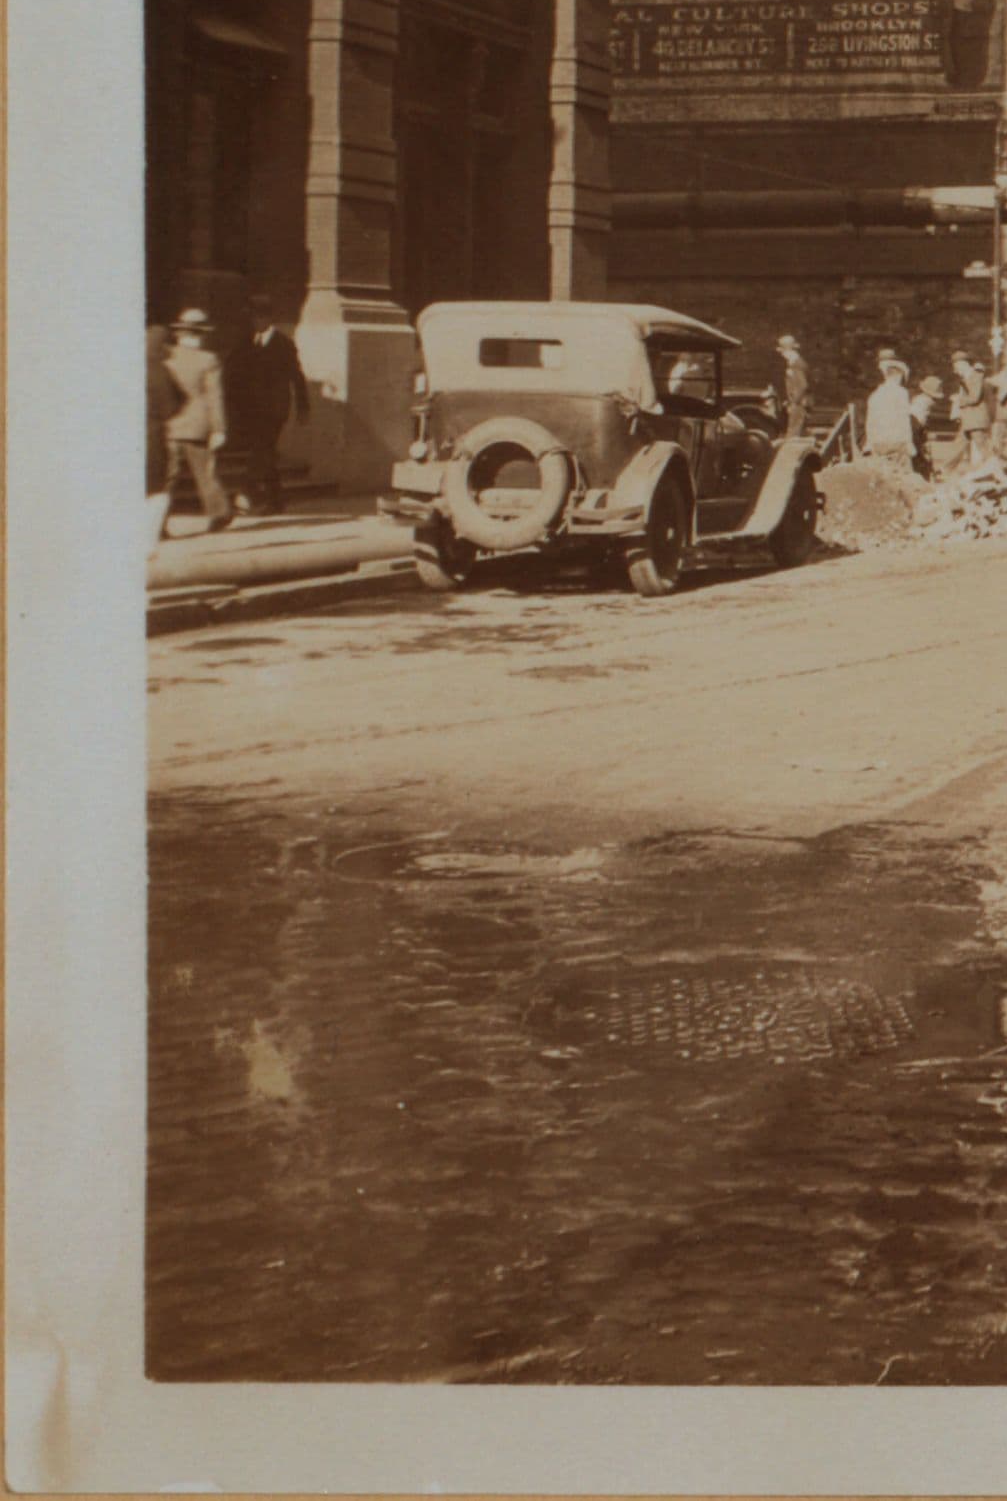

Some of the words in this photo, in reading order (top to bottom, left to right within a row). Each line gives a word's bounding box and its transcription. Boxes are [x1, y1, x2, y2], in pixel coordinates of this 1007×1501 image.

[832, 0, 929, 17] SHOPS
[815, 18, 922, 33] BROOKLYN
[842, 32, 921, 53] LIVINGSTON
